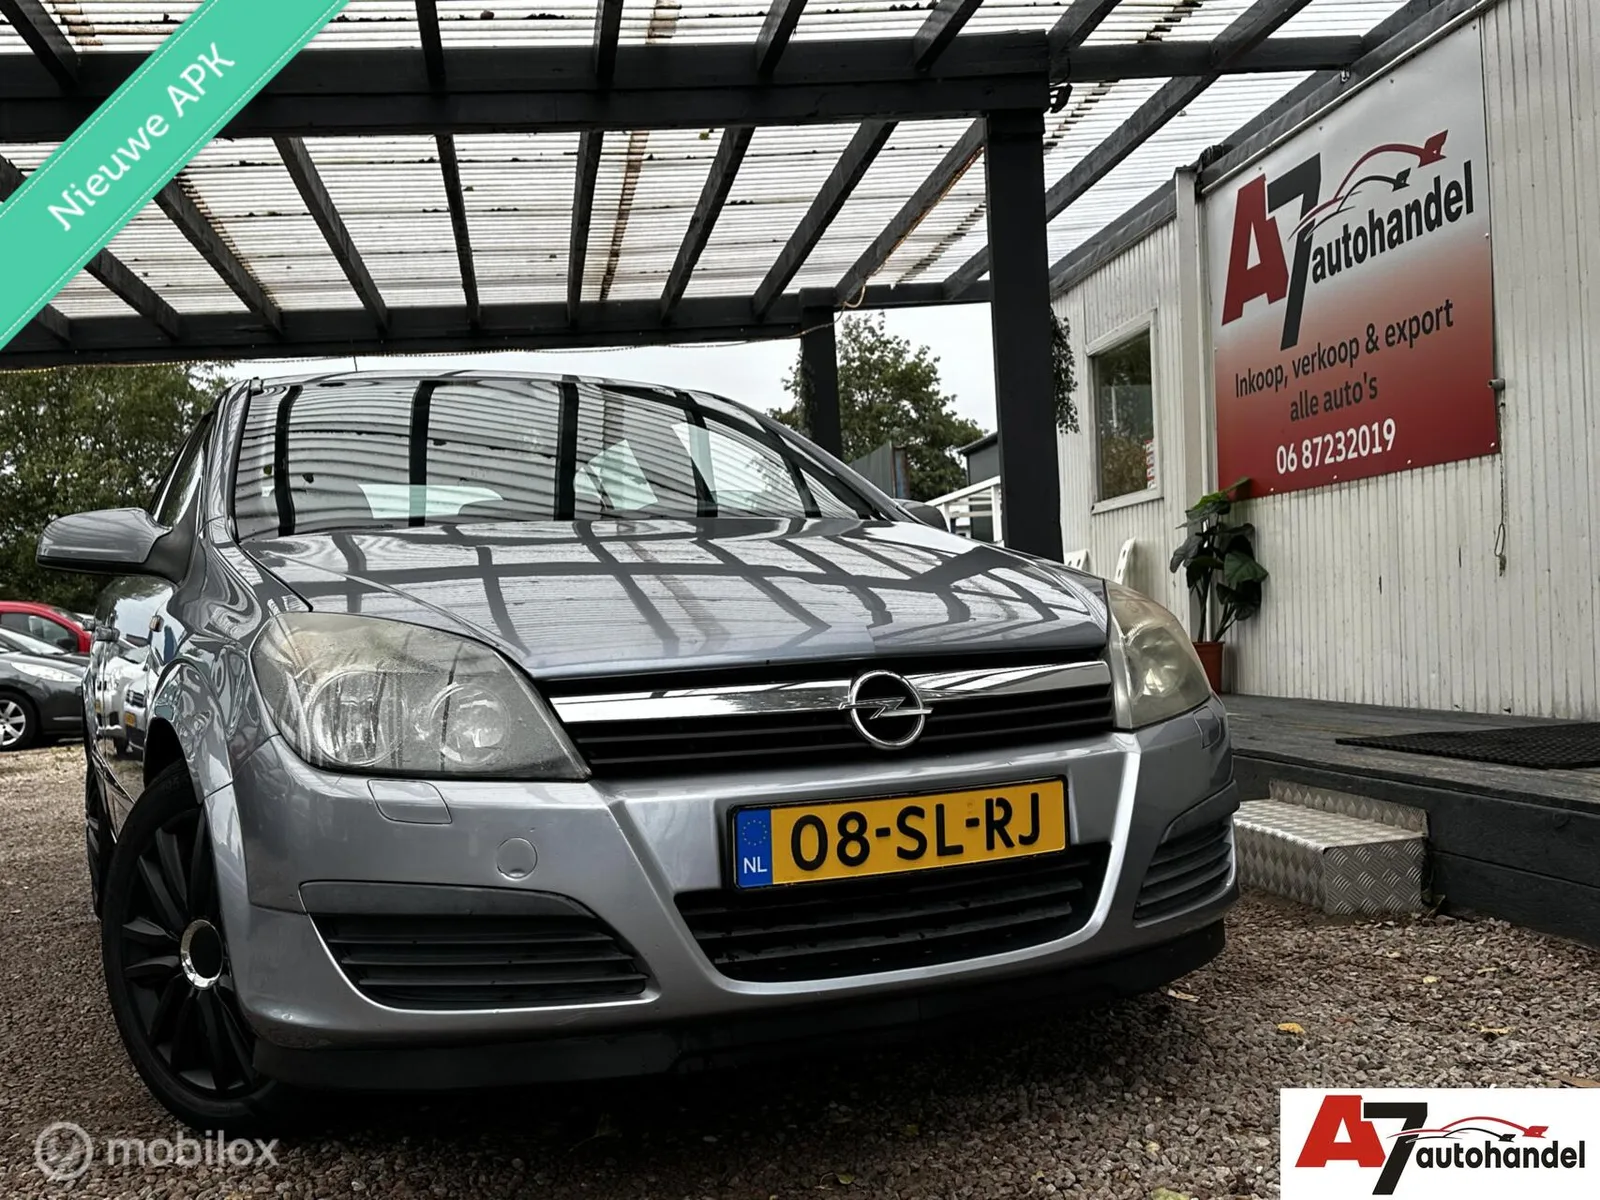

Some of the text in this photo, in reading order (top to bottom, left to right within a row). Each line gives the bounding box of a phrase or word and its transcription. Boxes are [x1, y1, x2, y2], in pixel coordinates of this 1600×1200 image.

[1222, 152, 1322, 351] A7
[1312, 160, 1474, 284] autohandel
[1235, 299, 1453, 398] Inkoop, verkoop & export
[1290, 372, 1378, 422] alle auto's
[1276, 418, 1396, 475] 06 87232019
[743, 857, 768, 874] NL
[790, 792, 1040, 871] 08-SL-RJ
